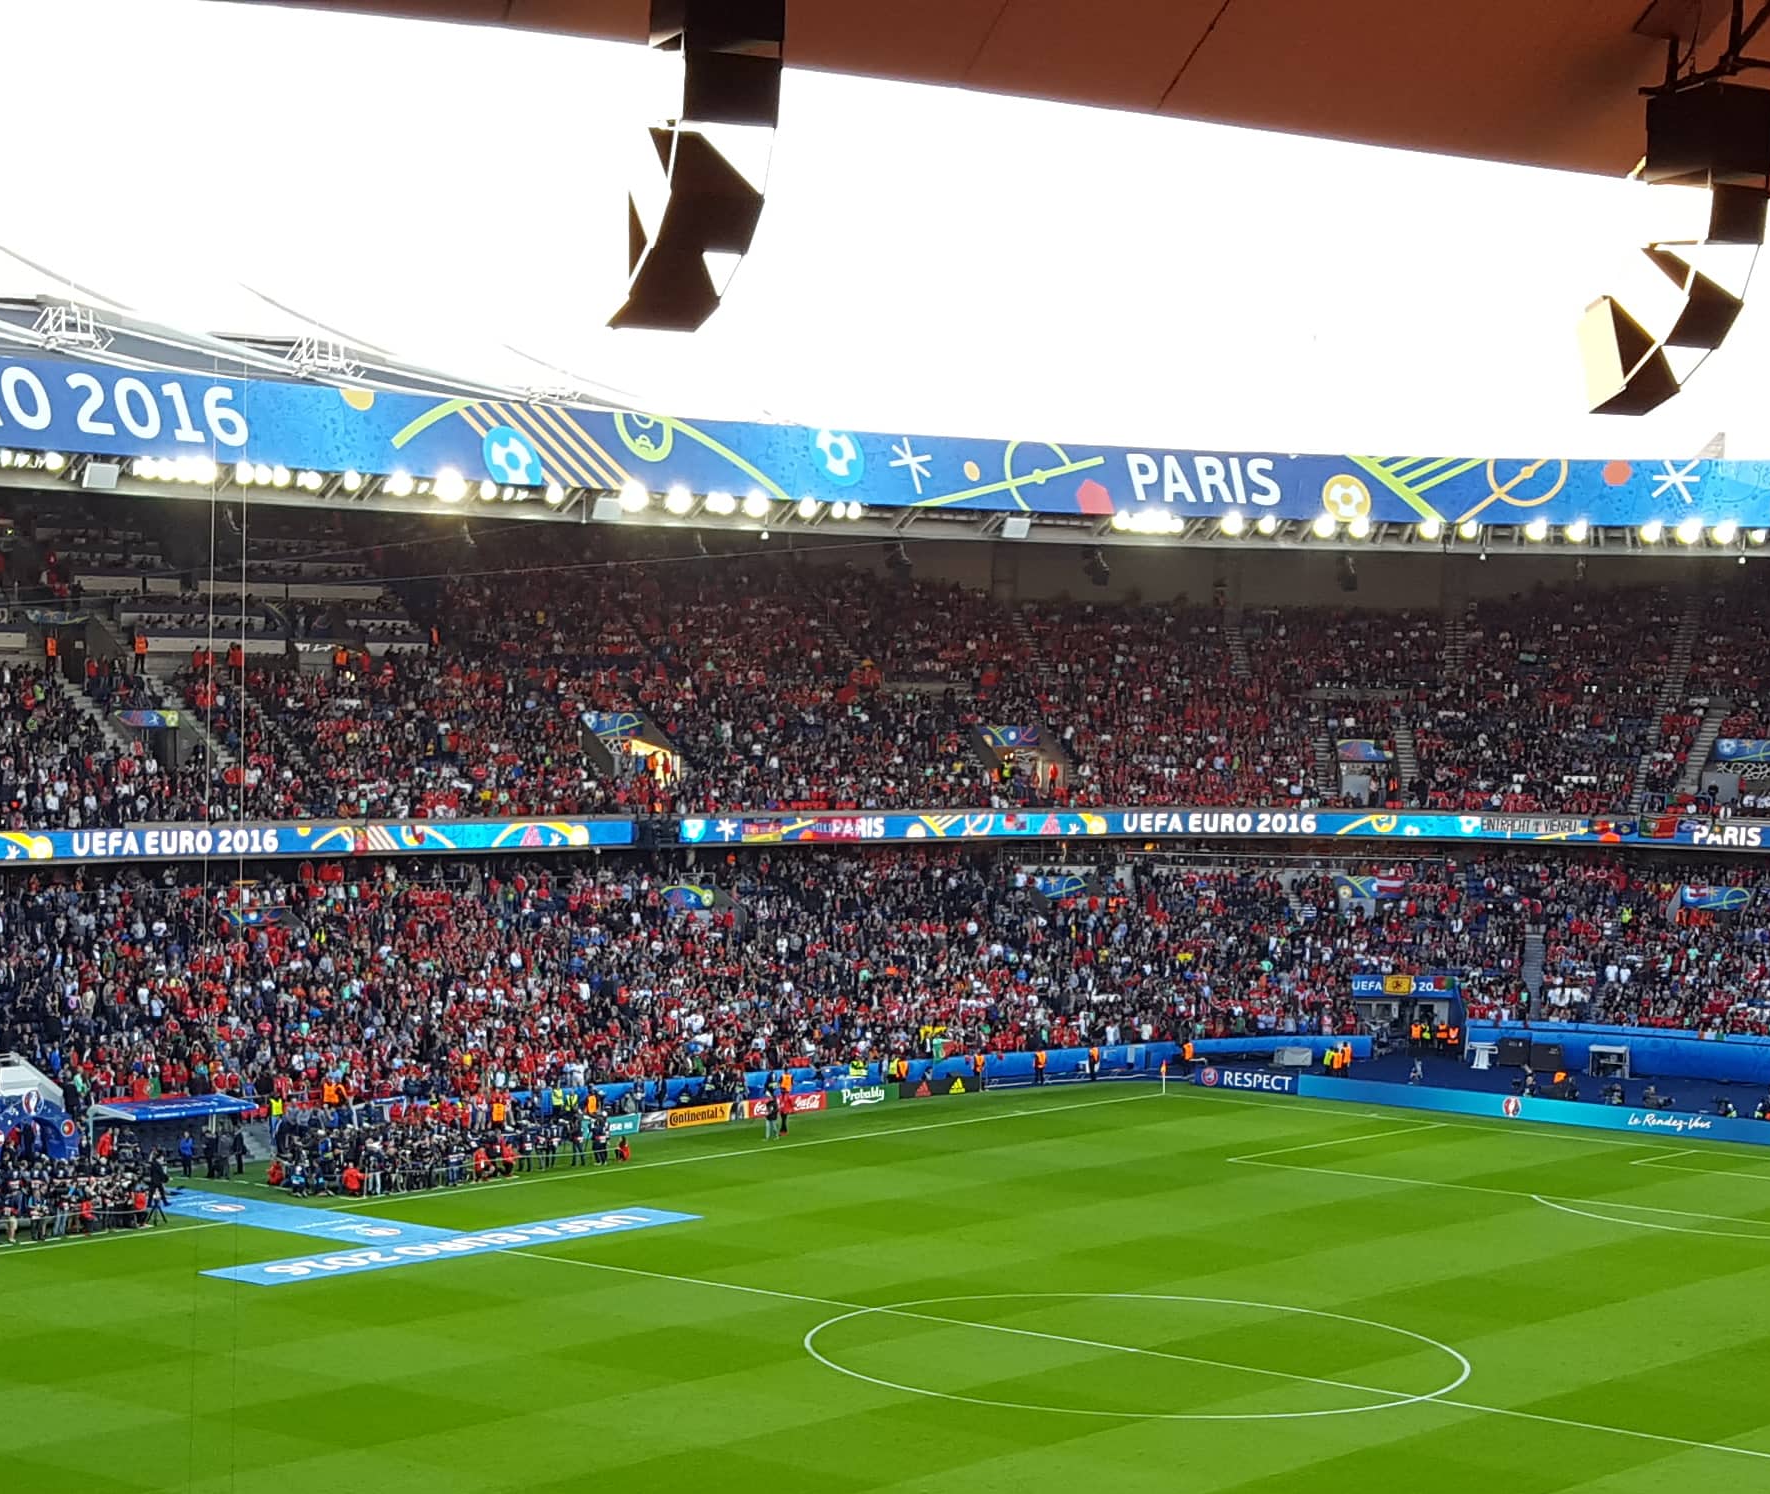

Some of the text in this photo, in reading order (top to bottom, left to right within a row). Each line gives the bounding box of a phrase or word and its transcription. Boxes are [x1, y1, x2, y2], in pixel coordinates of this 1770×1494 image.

[65, 372, 250, 448] 2016
[1126, 453, 1282, 505] PARIS
[831, 817, 885, 838] PARIS
[1122, 813, 1317, 834] UEFA EURO 2016
[72, 828, 278, 857] UEFA EURO 2016
[1693, 825, 1762, 847] PARIS
[1352, 980, 1382, 991] UEFA
[1223, 1071, 1293, 1091] RESPECT
[841, 1088, 885, 1105] Probably
[669, 1108, 718, 1127] Continental
[1628, 1113, 1712, 1132] Le Rendez-Vous
[262, 1213, 653, 1277] UEFA EURO 2016
